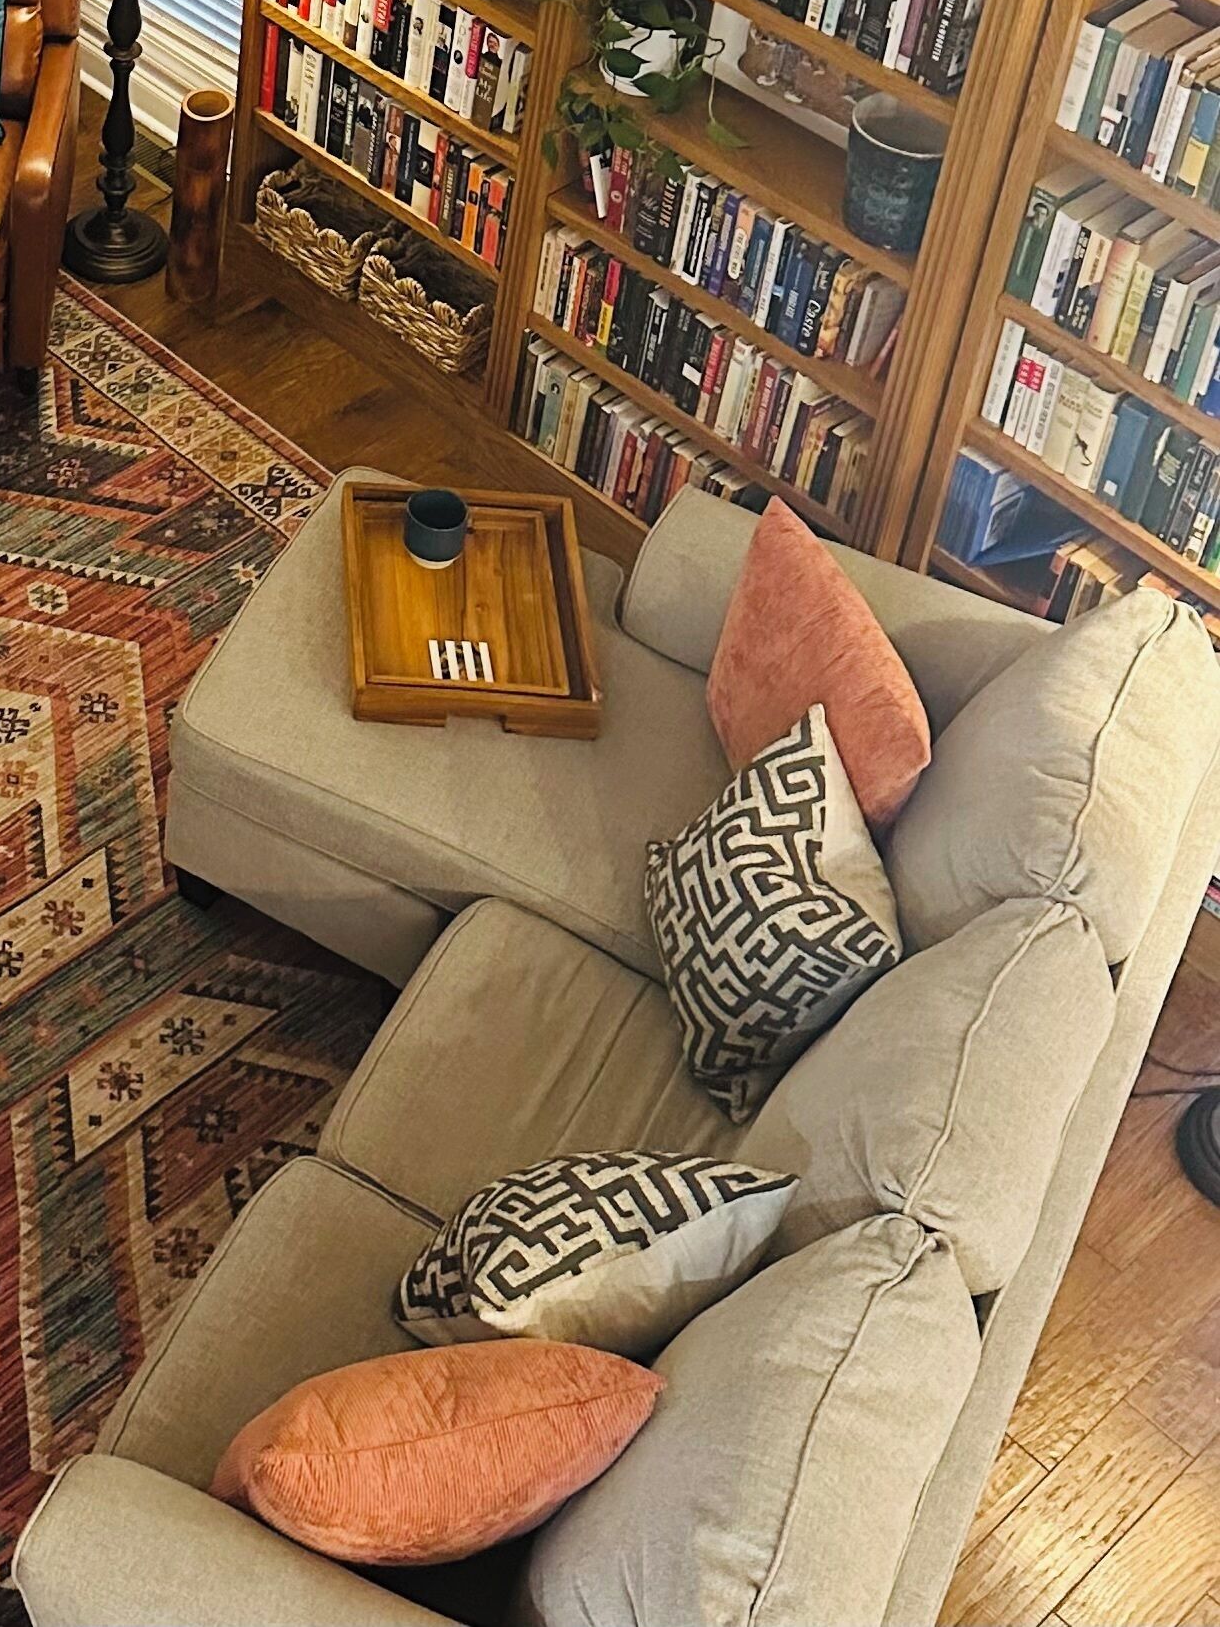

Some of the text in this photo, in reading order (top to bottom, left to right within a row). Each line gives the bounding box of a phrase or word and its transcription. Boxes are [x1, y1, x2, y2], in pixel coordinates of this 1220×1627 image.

[304, 54, 317, 88] GRANT
[475, 86, 493, 103] Life
[478, 78, 492, 93] My
[801, 298, 821, 339] Caste
